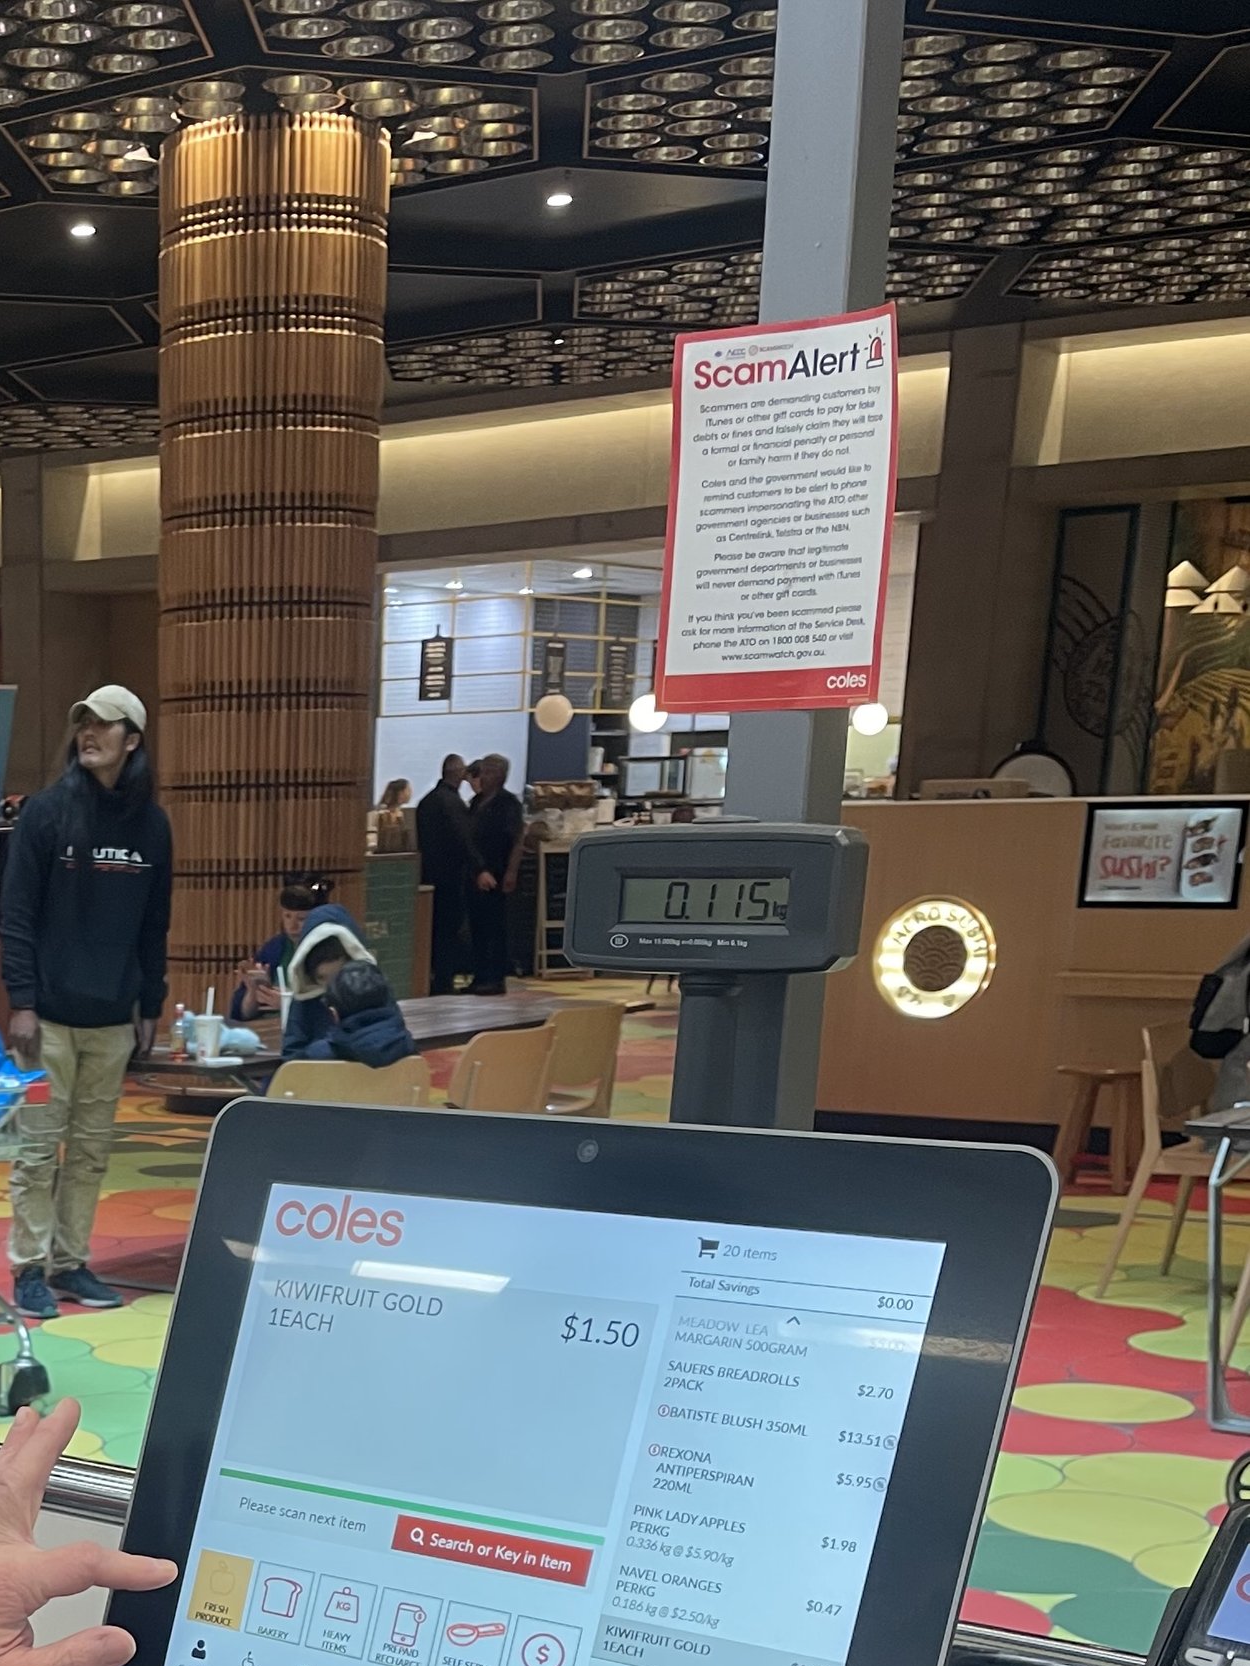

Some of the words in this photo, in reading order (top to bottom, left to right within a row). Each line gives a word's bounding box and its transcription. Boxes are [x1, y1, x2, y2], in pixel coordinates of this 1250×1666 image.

[694, 343, 860, 389] ScamAlert
[700, 402, 748, 413] Scammers
[751, 400, 765, 408] are
[768, 393, 820, 406] demanding
[823, 387, 866, 399] customers
[868, 385, 880, 394] buy
[696, 565, 749, 579] government
[751, 561, 806, 574] departments
[809, 560, 817, 568] or
[819, 556, 862, 567] businesses
[688, 615, 694, 623] If
[696, 615, 712, 624] you
[714, 613, 735, 622] think
[737, 611, 765, 621] you've
[767, 609, 789, 618] been
[792, 606, 833, 617] scammed
[835, 604, 862, 615] please
[693, 639, 721, 650] phone
[724, 639, 737, 647] the
[739, 637, 756, 646] ATO
[773, 636, 792, 645] 1800
[795, 634, 809, 643] 008
[812, 634, 827, 642] 540
[839, 632, 853, 640] visit
[827, 672, 867, 688] coles
[664, 881, 772, 921] 0.115
[772, 901, 788, 920] kg
[275, 1195, 404, 1247] coles
[723, 1245, 741, 1257] 20
[743, 1245, 778, 1261] items
[689, 1276, 715, 1290] Total
[718, 1280, 760, 1296] Savings
[274, 1279, 380, 1309] KIWIFRUIT
[383, 1292, 443, 1316] GOLD
[877, 1296, 914, 1311] $0.00
[268, 1307, 334, 1334] 1EACH
[560, 1312, 640, 1347] $1.50
[678, 1315, 740, 1333] MEADOW
[745, 1323, 769, 1336] LEA
[674, 1330, 745, 1349] MARGARIN
[746, 1340, 808, 1357] 500GRAM
[668, 1360, 715, 1376] SAUERS
[717, 1367, 800, 1387] BREADROLLS
[664, 1376, 704, 1392] 2PACK
[857, 1384, 894, 1400] $2.70
[670, 1407, 719, 1424] BATISTE
[721, 1413, 763, 1431] BLUSH
[766, 1420, 809, 1437] 350ML
[838, 1430, 881, 1448] $13.51
[660, 1446, 712, 1464] REXONA
[655, 1462, 755, 1488] ANTIPERSPIRAN
[836, 1472, 872, 1489] $5.95
[652, 1477, 693, 1495] 220ML
[239, 1496, 277, 1516] Please
[279, 1508, 306, 1522] scan
[309, 1513, 336, 1528] next
[338, 1517, 366, 1532] item
[633, 1504, 663, 1519] PINK
[665, 1510, 699, 1526] LADY
[699, 1516, 746, 1534] APPLES
[630, 1520, 670, 1538] PERKG
[429, 1532, 474, 1554] Search
[477, 1544, 492, 1557] or
[495, 1544, 521, 1565] Key
[523, 1550, 537, 1566] in
[540, 1553, 572, 1572] Item
[821, 1536, 857, 1553] $1.98
[619, 1565, 659, 1583] NAVEL
[661, 1573, 723, 1594] ORANGES
[616, 1580, 656, 1598] PERKG
[203, 1602, 229, 1615] FRESH
[335, 1601, 351, 1611] KG
[806, 1599, 843, 1617] $0.47
[195, 1612, 233, 1626] PRODUCE
[257, 1626, 289, 1640] BAKERY
[323, 1629, 350, 1642] HEAVY
[606, 1624, 672, 1648] KIWIFRUIT
[674, 1638, 711, 1656] GOLD
[322, 1641, 347, 1653] ITEMS
[382, 1643, 419, 1658] PREPAID
[603, 1640, 644, 1658] 1EACH
